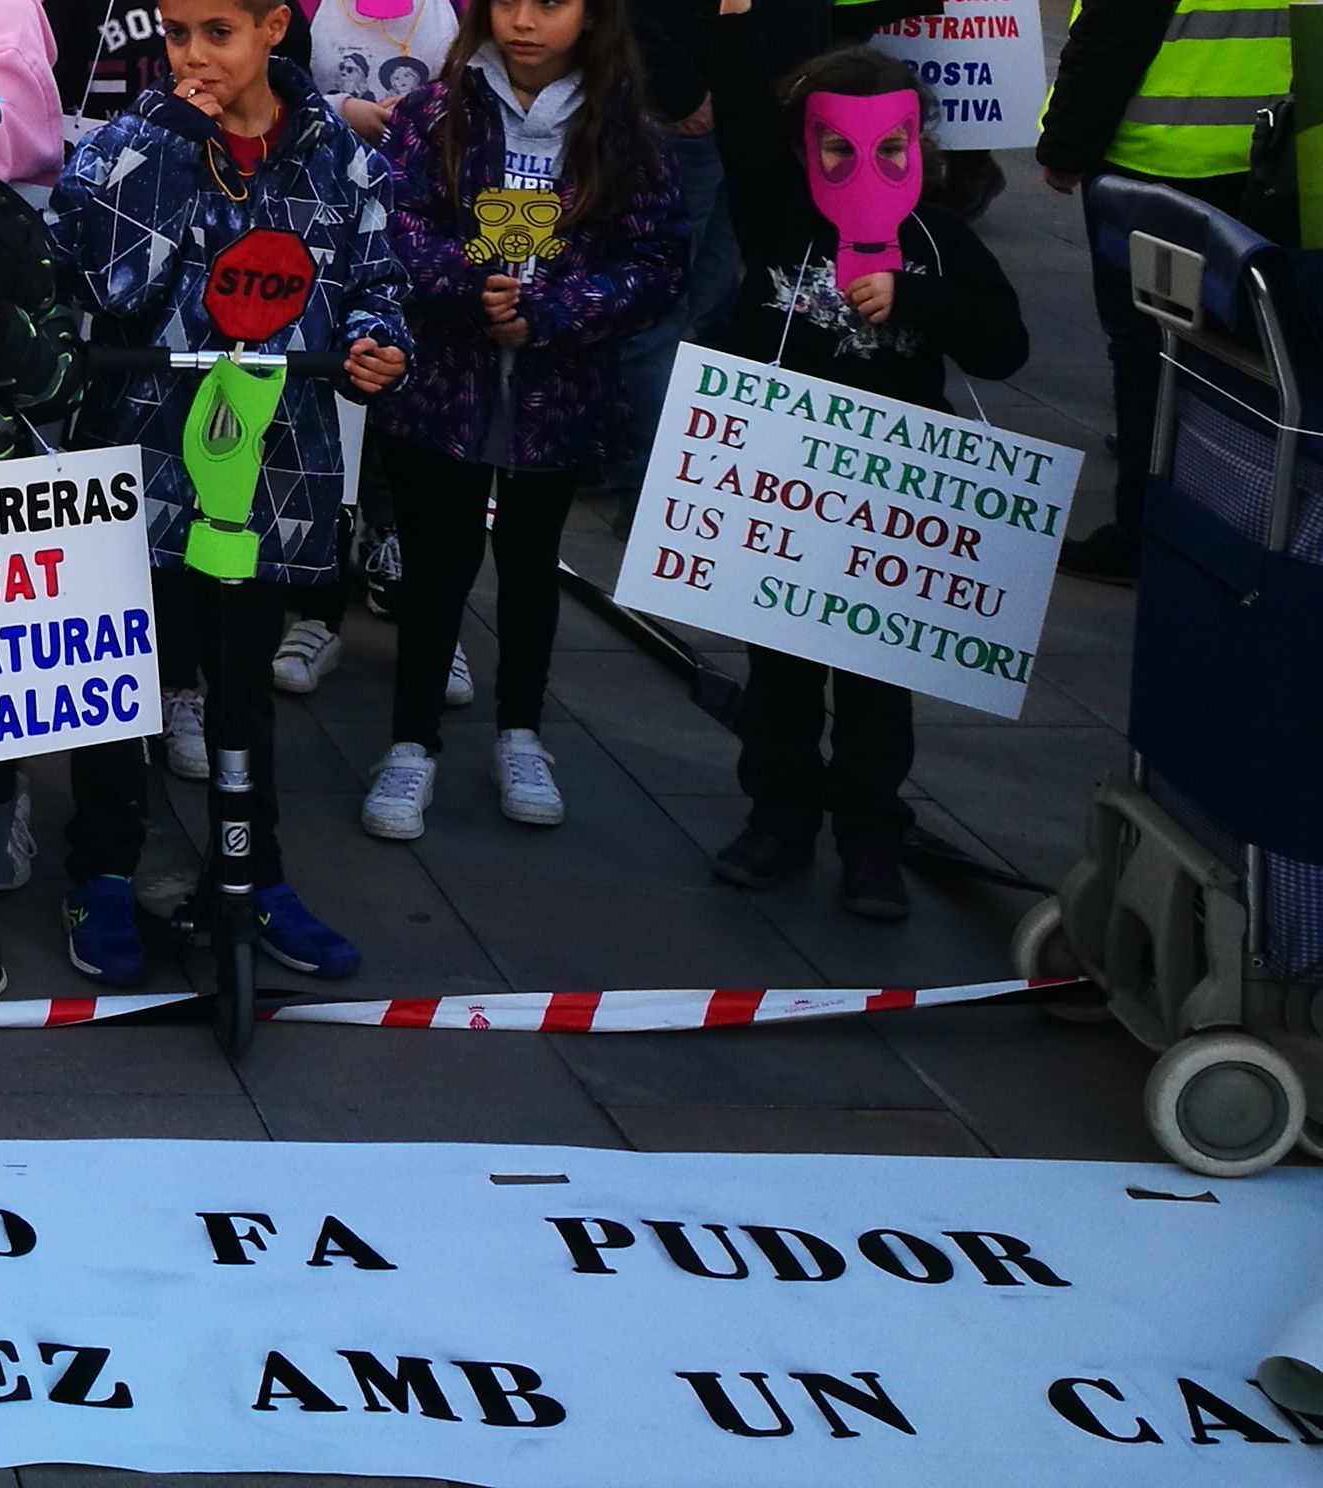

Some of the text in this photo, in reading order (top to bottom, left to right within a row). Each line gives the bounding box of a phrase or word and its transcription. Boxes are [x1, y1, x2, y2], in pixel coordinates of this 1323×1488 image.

[215, 266, 305, 308] STOP
[684, 406, 1062, 538] DE TERRITORI
[695, 364, 1053, 486] DEPARTAMENT
[663, 496, 1007, 618] US EL FOTEU
[675, 450, 982, 562] L'ABOCADOR
[653, 546, 1036, 685] DE SUPOSITORI
[195, 1210, 398, 1272] FA
[544, 1216, 1072, 1289] PUDOR
[251, 1349, 569, 1430] AMB
[675, 1371, 918, 1439] UN
